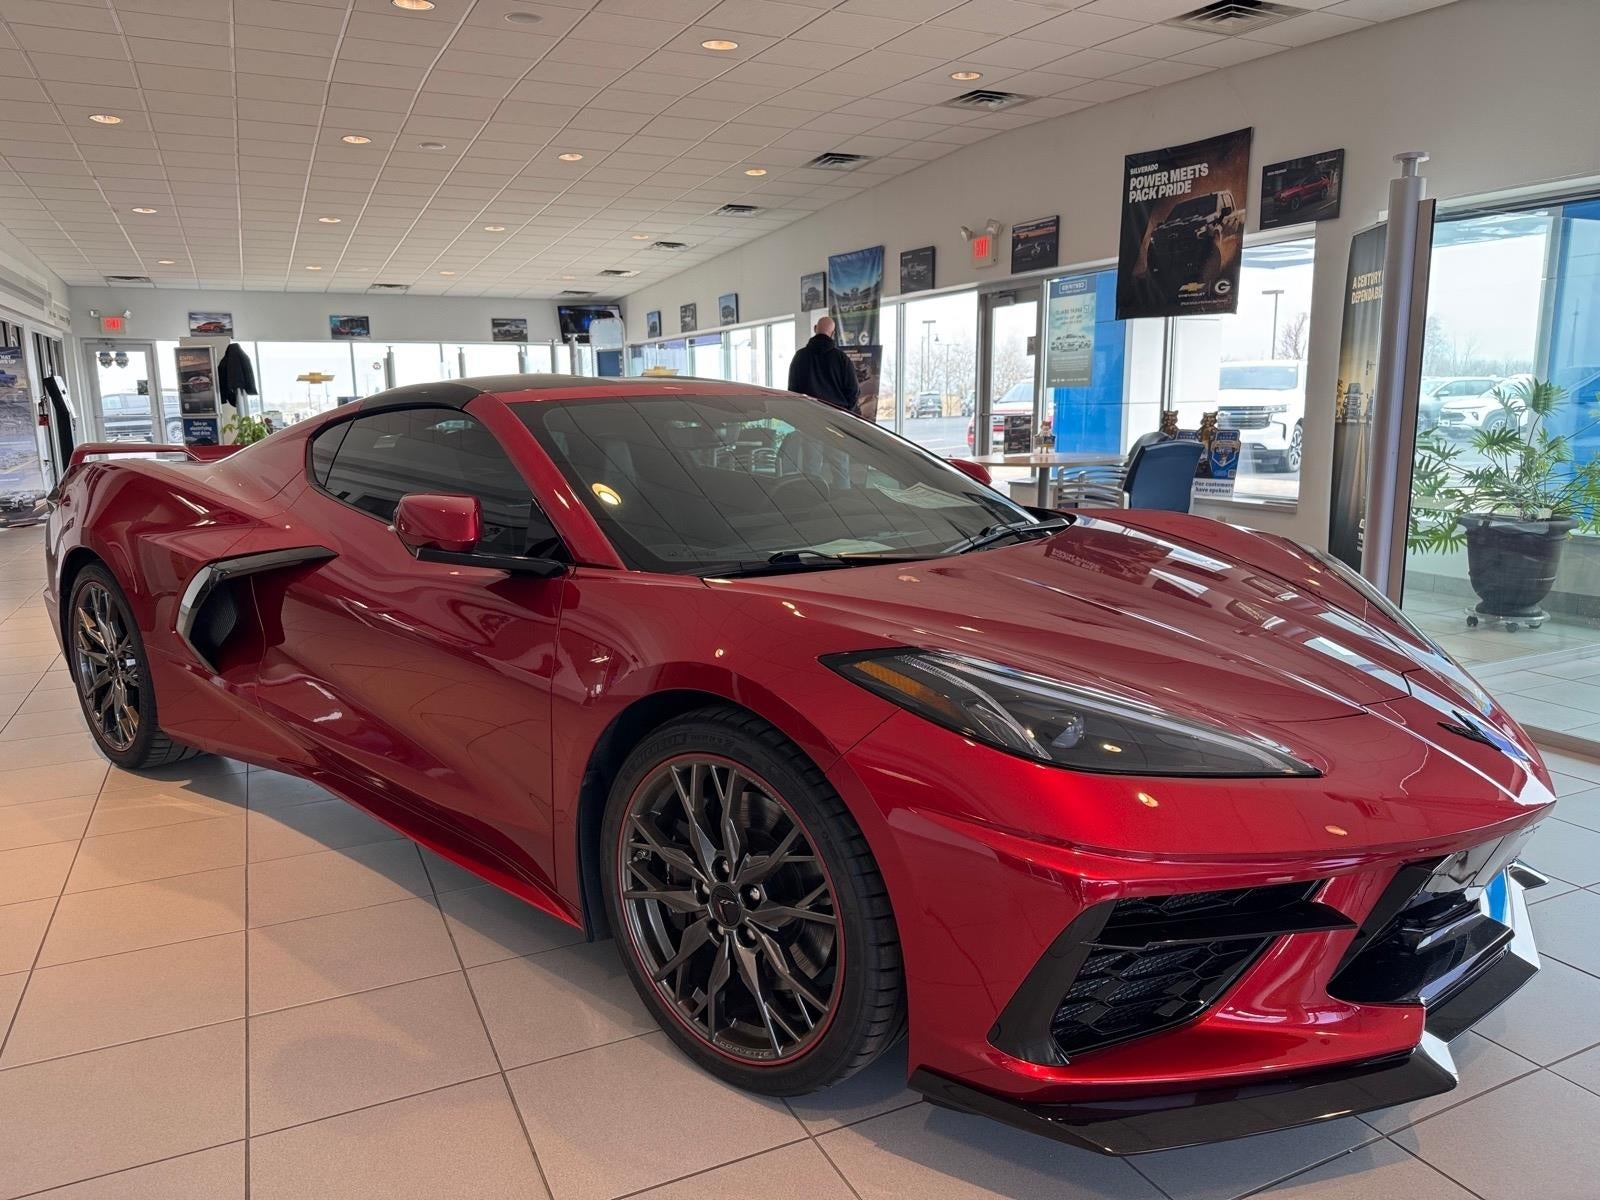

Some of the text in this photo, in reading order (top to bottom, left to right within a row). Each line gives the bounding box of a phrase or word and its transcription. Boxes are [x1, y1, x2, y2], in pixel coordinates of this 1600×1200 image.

[1129, 162, 1209, 190] POWER MEETS
[1130, 163, 1158, 175] SILVERADO
[1128, 180, 1192, 204] PACK PRIDE
[974, 239, 988, 257] EXIT
[1352, 269, 1382, 290] A CENTURY
[720, 1041, 771, 1058] CORVETTE
